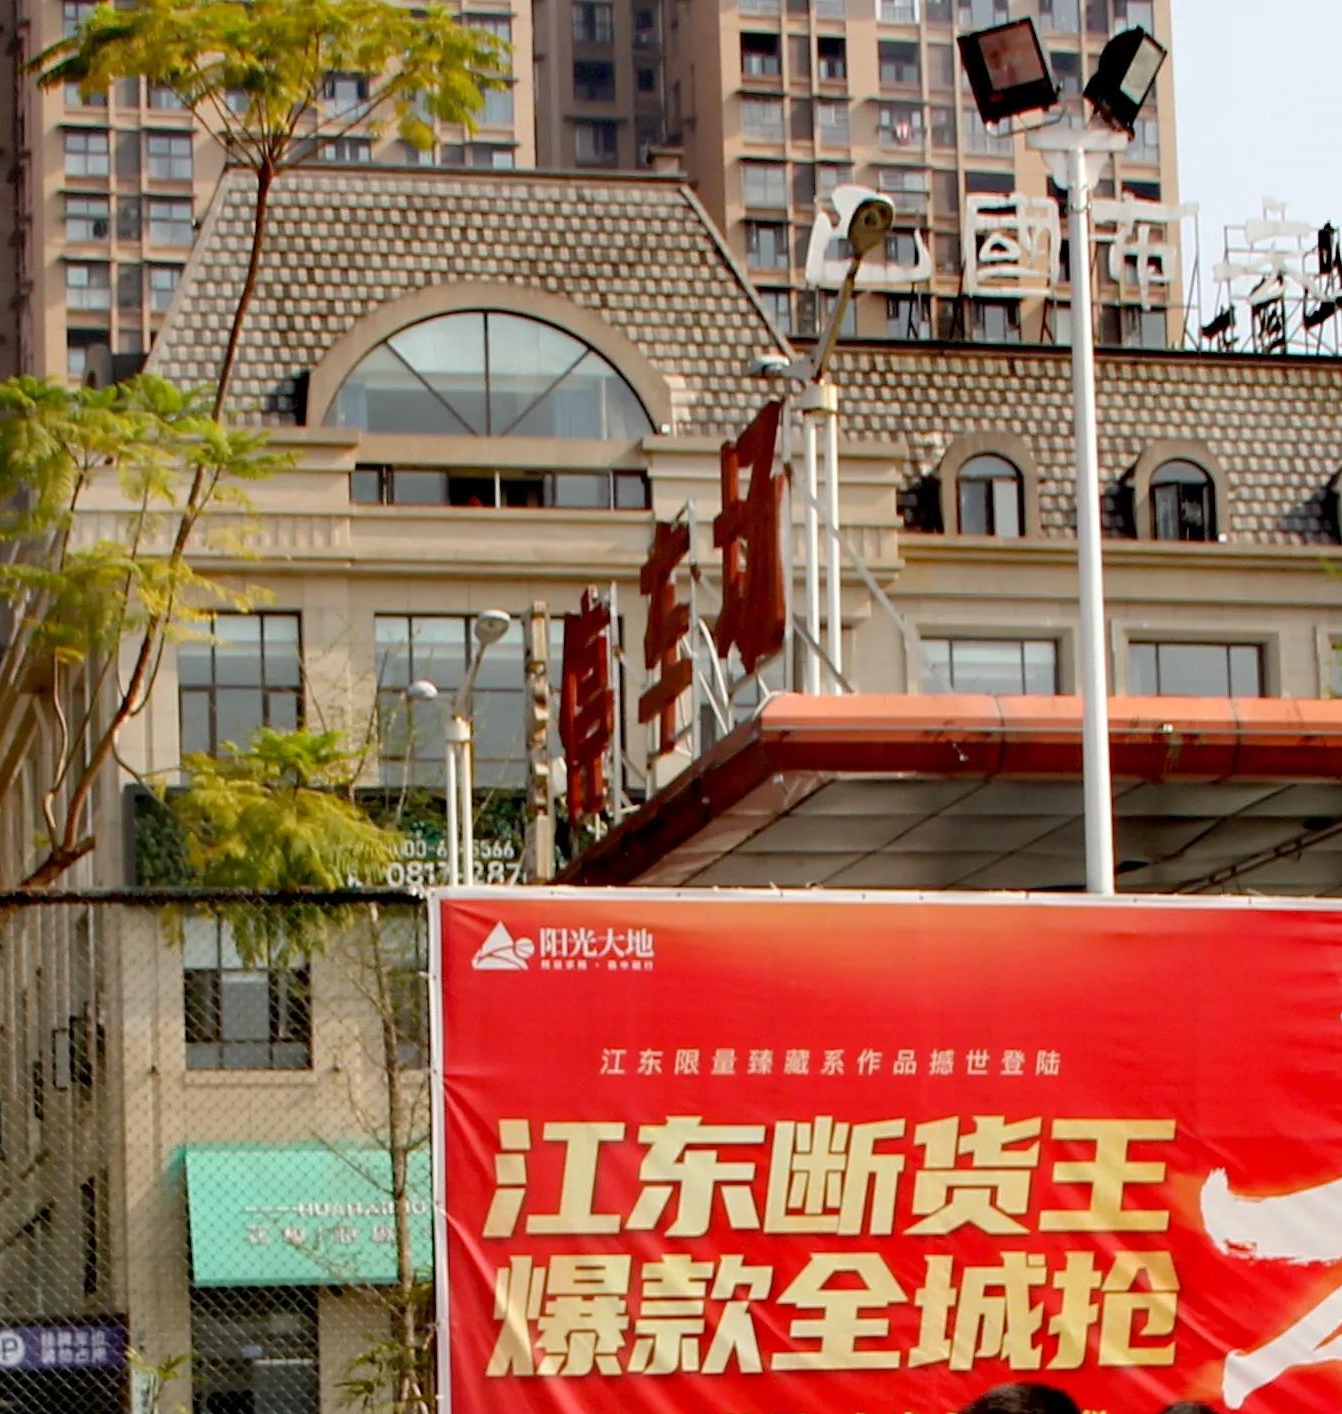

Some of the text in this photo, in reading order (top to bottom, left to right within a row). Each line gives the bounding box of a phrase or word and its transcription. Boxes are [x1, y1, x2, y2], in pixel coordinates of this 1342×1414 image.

[539, 927, 655, 958] 阳光大地
[600, 1048, 1062, 1077] 江东限量臻藏系作品撼世登陆
[482, 1115, 1177, 1238] 江东断货王
[485, 1251, 1181, 1378] 爆款全城抢
